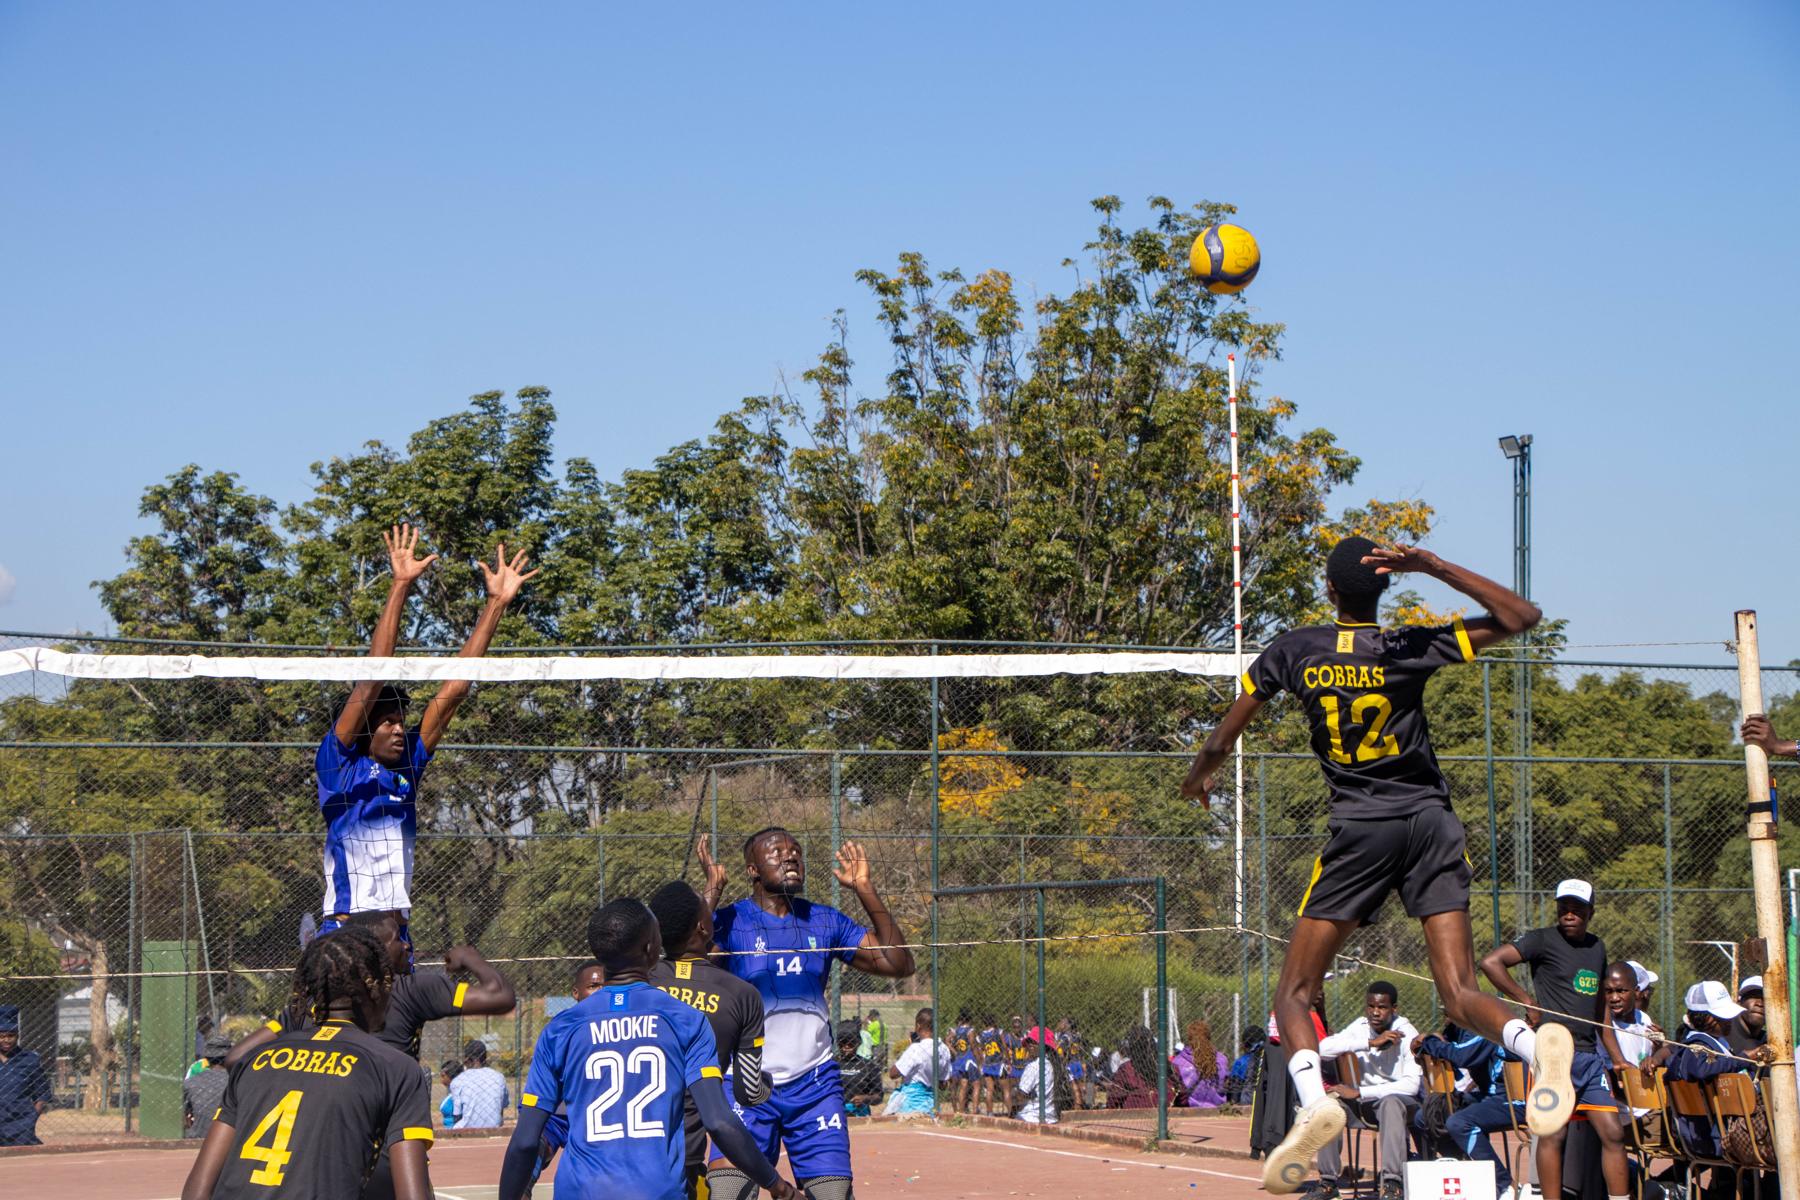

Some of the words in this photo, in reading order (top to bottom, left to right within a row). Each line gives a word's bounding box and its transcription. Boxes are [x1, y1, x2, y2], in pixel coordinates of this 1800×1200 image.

[1303, 664, 1385, 689] COBRAS
[1319, 693, 1400, 764] 12
[776, 956, 803, 977] 14
[590, 1015, 659, 1046] MOOKIE
[252, 1048, 359, 1078] COBRAS
[585, 1045, 667, 1143] 22
[816, 1112, 843, 1131] 14
[239, 1090, 305, 1187] 4
